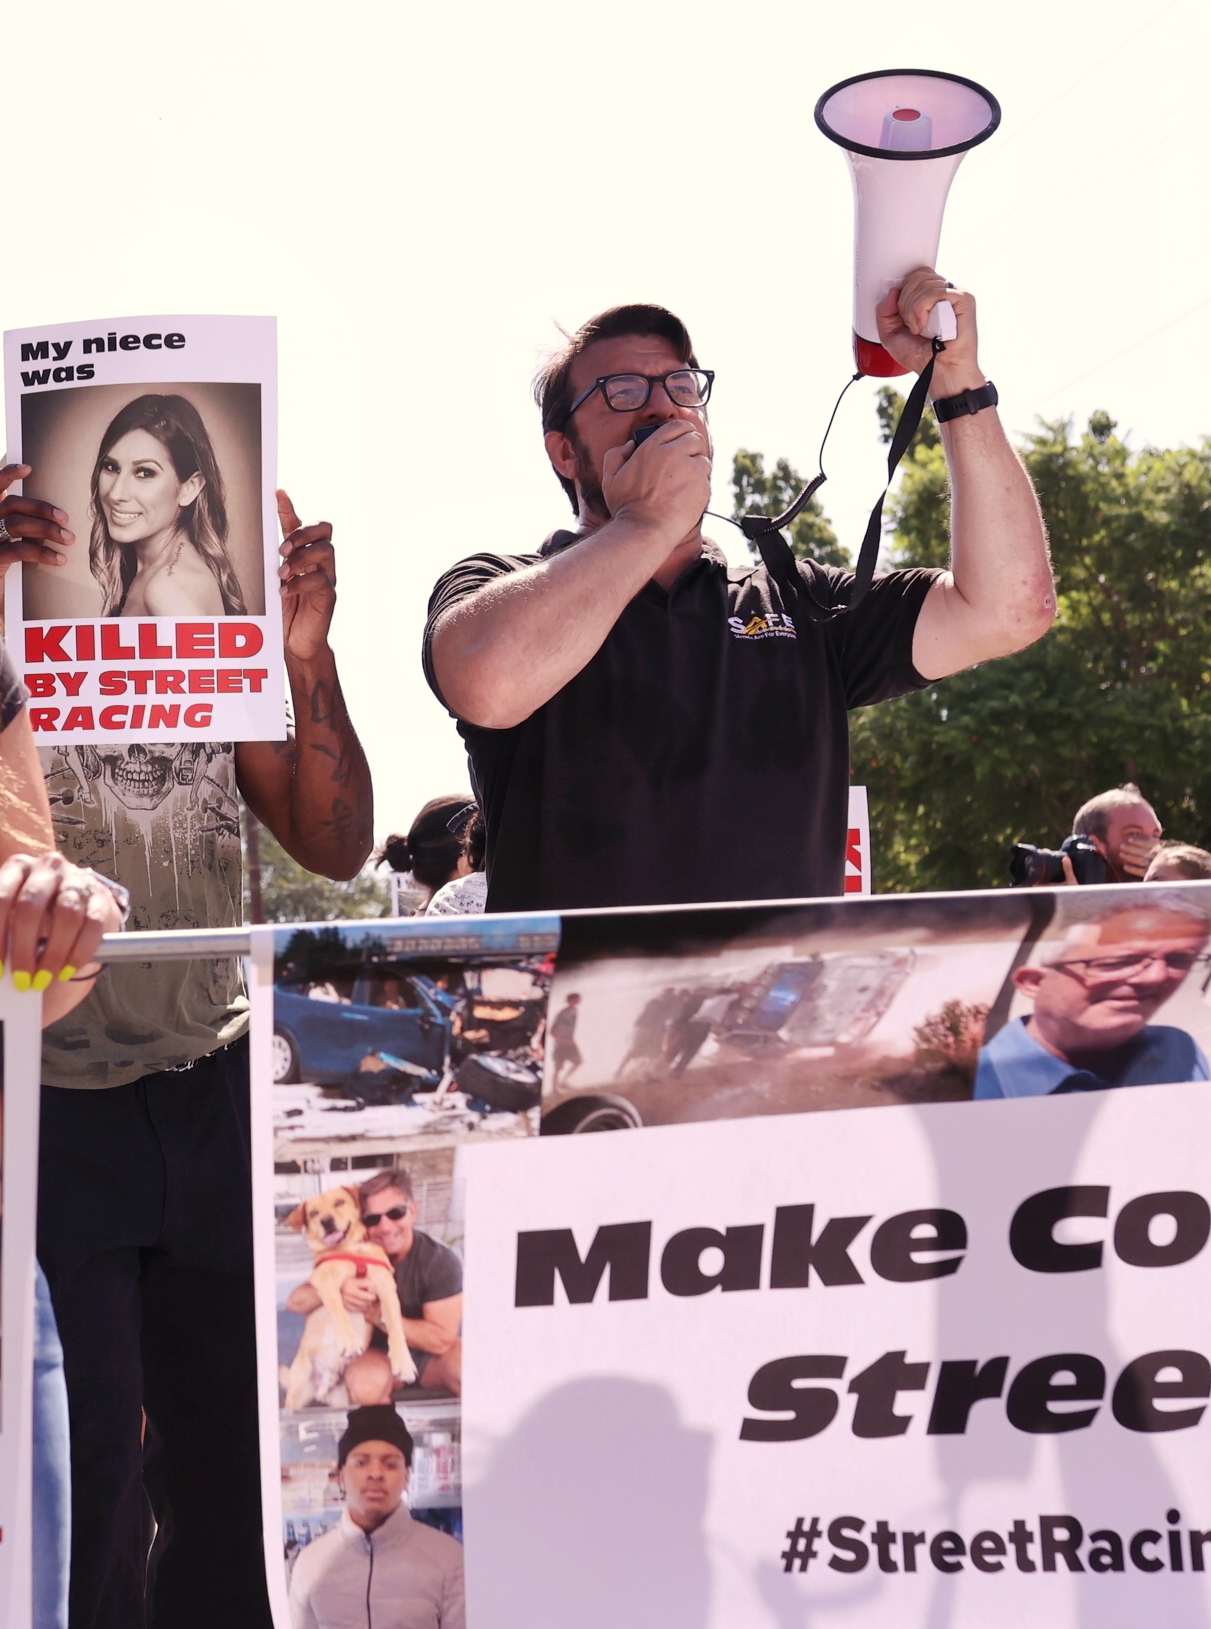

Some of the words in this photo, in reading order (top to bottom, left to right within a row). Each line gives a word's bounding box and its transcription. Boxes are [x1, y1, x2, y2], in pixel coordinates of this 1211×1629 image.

[20, 340, 73, 362] My
[82, 332, 186, 356] niece
[20, 363, 95, 388] was
[727, 613, 795, 634] SAFE
[25, 622, 265, 663] KILLED
[24, 671, 89, 699] BY
[99, 668, 269, 698] STREET
[28, 703, 214, 733] RACING
[514, 1203, 968, 1308] Make
[739, 1350, 1211, 1442] stree
